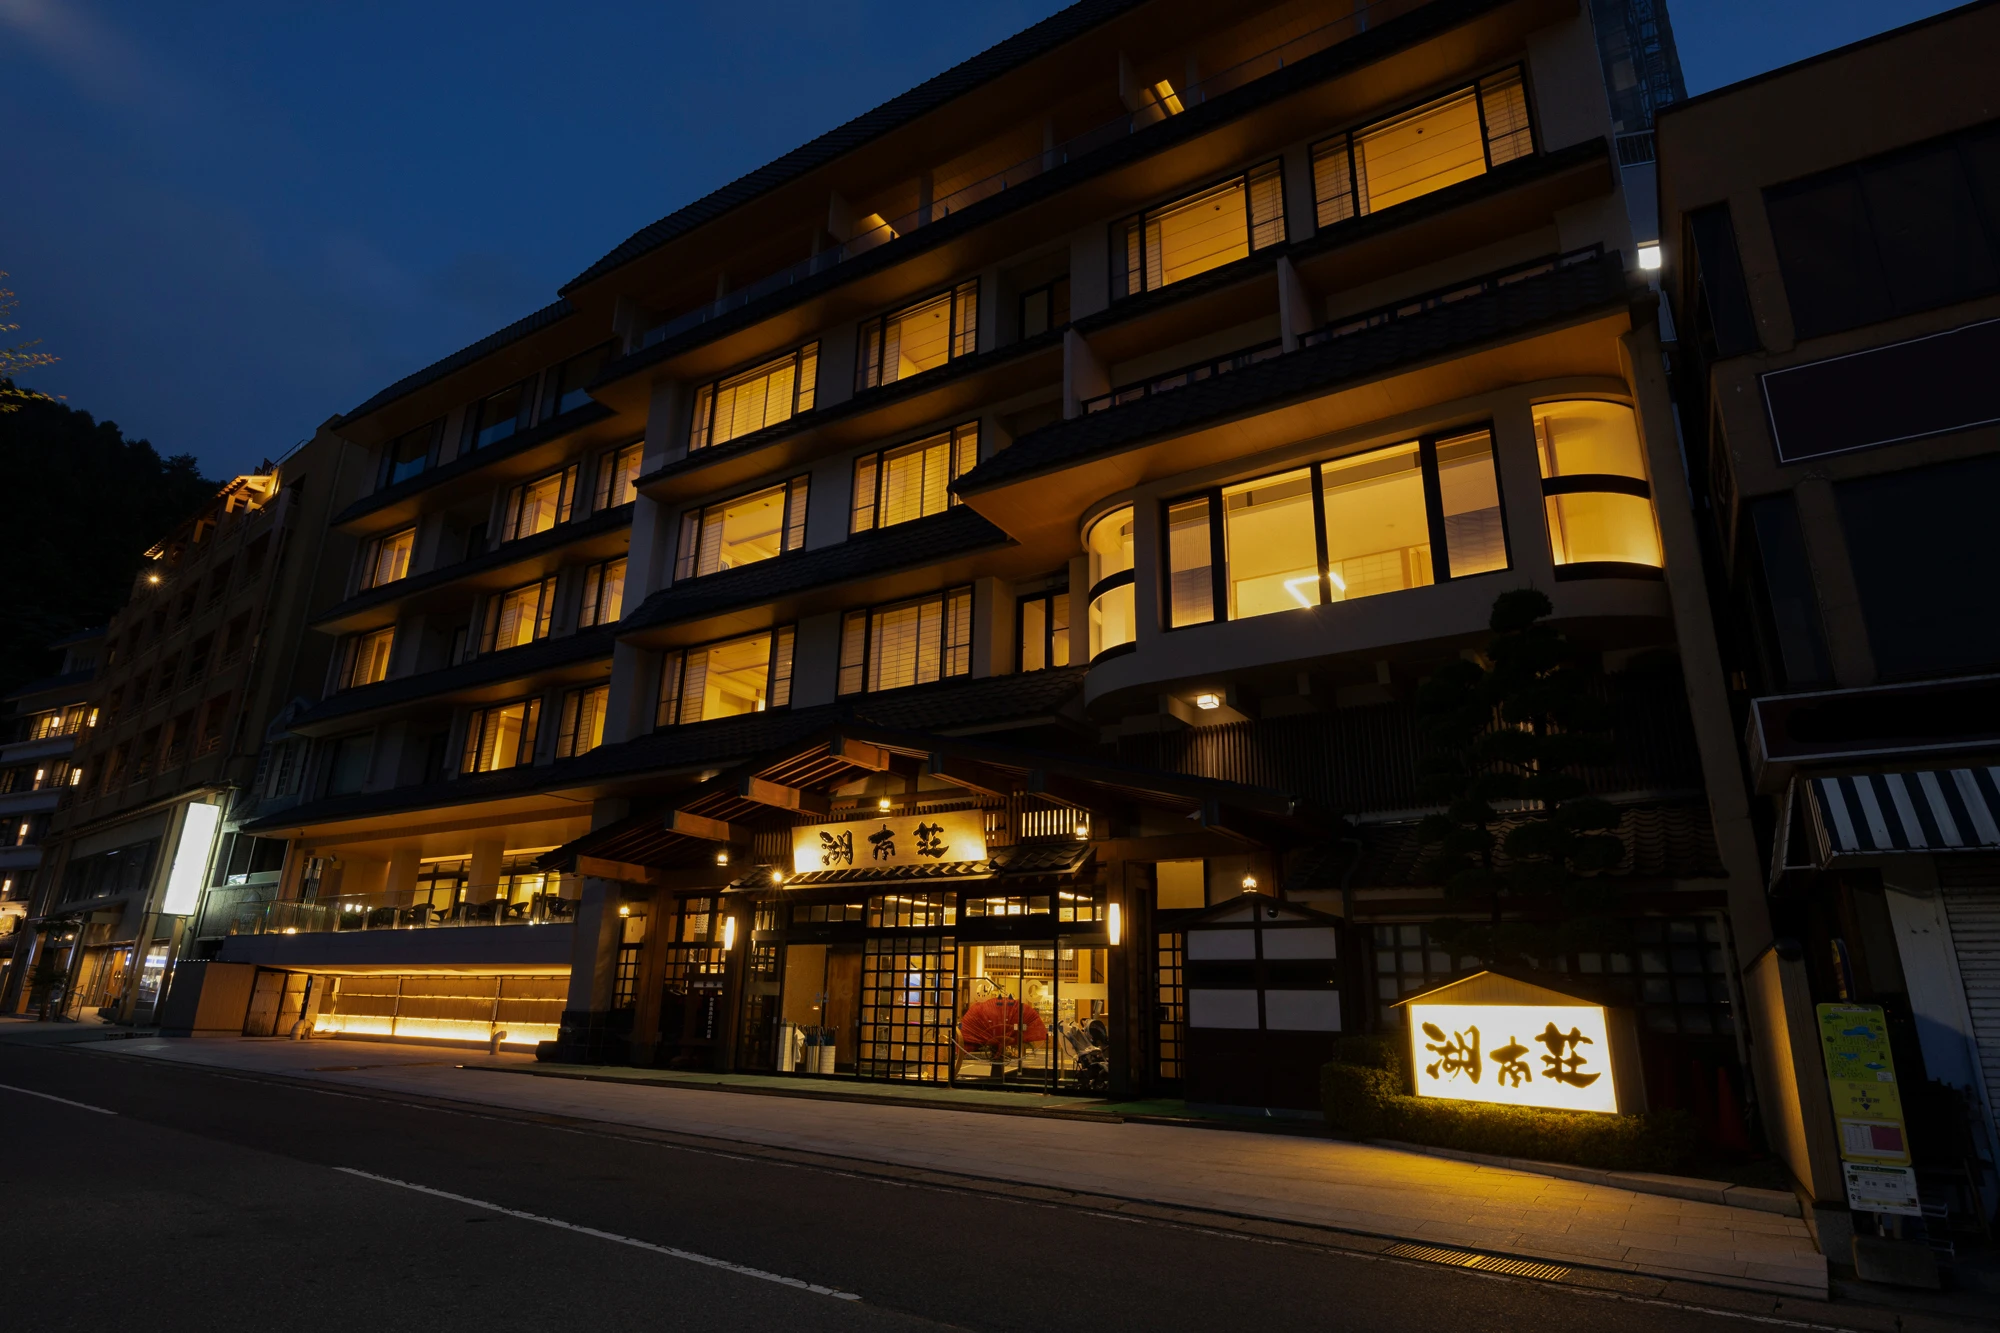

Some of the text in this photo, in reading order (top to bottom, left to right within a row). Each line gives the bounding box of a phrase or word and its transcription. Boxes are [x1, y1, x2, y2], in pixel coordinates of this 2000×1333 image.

[819, 821, 950, 866] 湖南荘
[1421, 1021, 1602, 1089] 湖南荘
